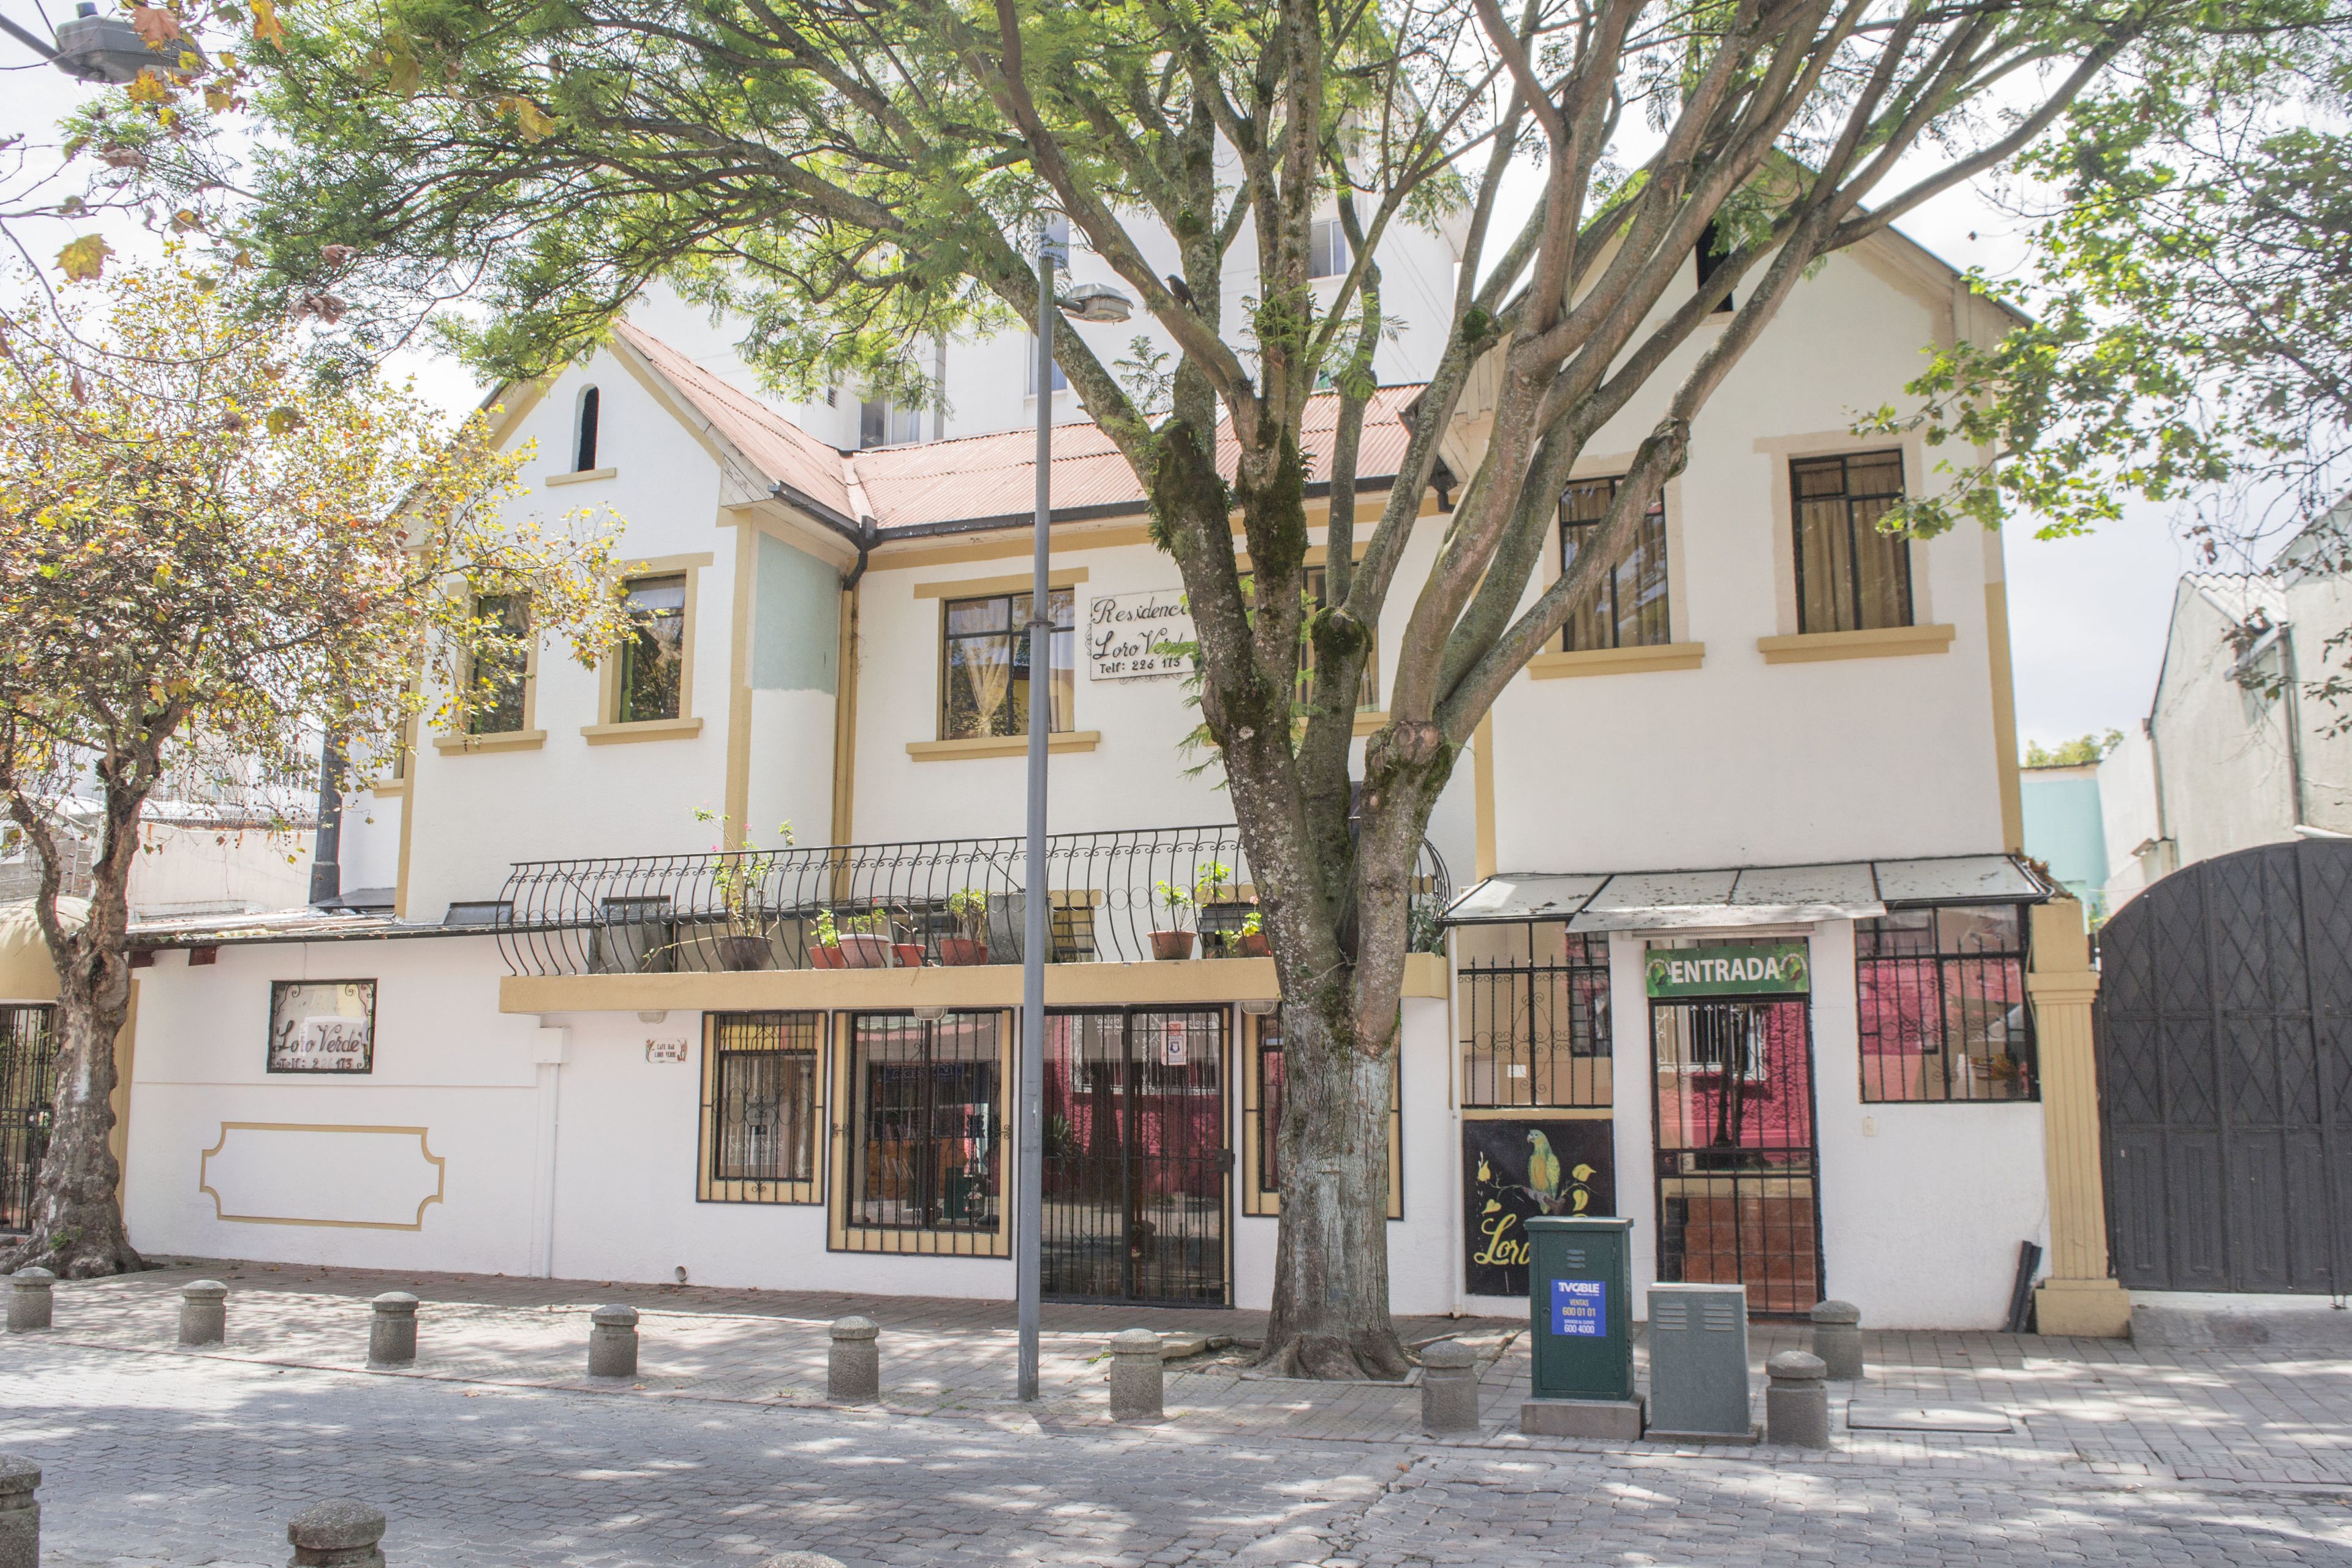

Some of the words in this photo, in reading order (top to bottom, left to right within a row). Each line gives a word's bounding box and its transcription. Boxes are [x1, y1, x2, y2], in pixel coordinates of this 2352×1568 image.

[1093, 597, 1187, 624] Residenci
[1092, 630, 1140, 660] Loro
[1099, 662, 1125, 674] Telf:
[1132, 659, 1154, 671] 226
[1671, 957, 1781, 984] ENTRADA
[273, 1020, 316, 1053] Loro
[315, 1024, 360, 1053] Verde
[1562, 1306, 1576, 1316] 600
[1577, 1307, 1586, 1317] 01
[1587, 1308, 1596, 1317] 01
[1564, 1324, 1577, 1333] 600
[1578, 1324, 1595, 1334] 4000
